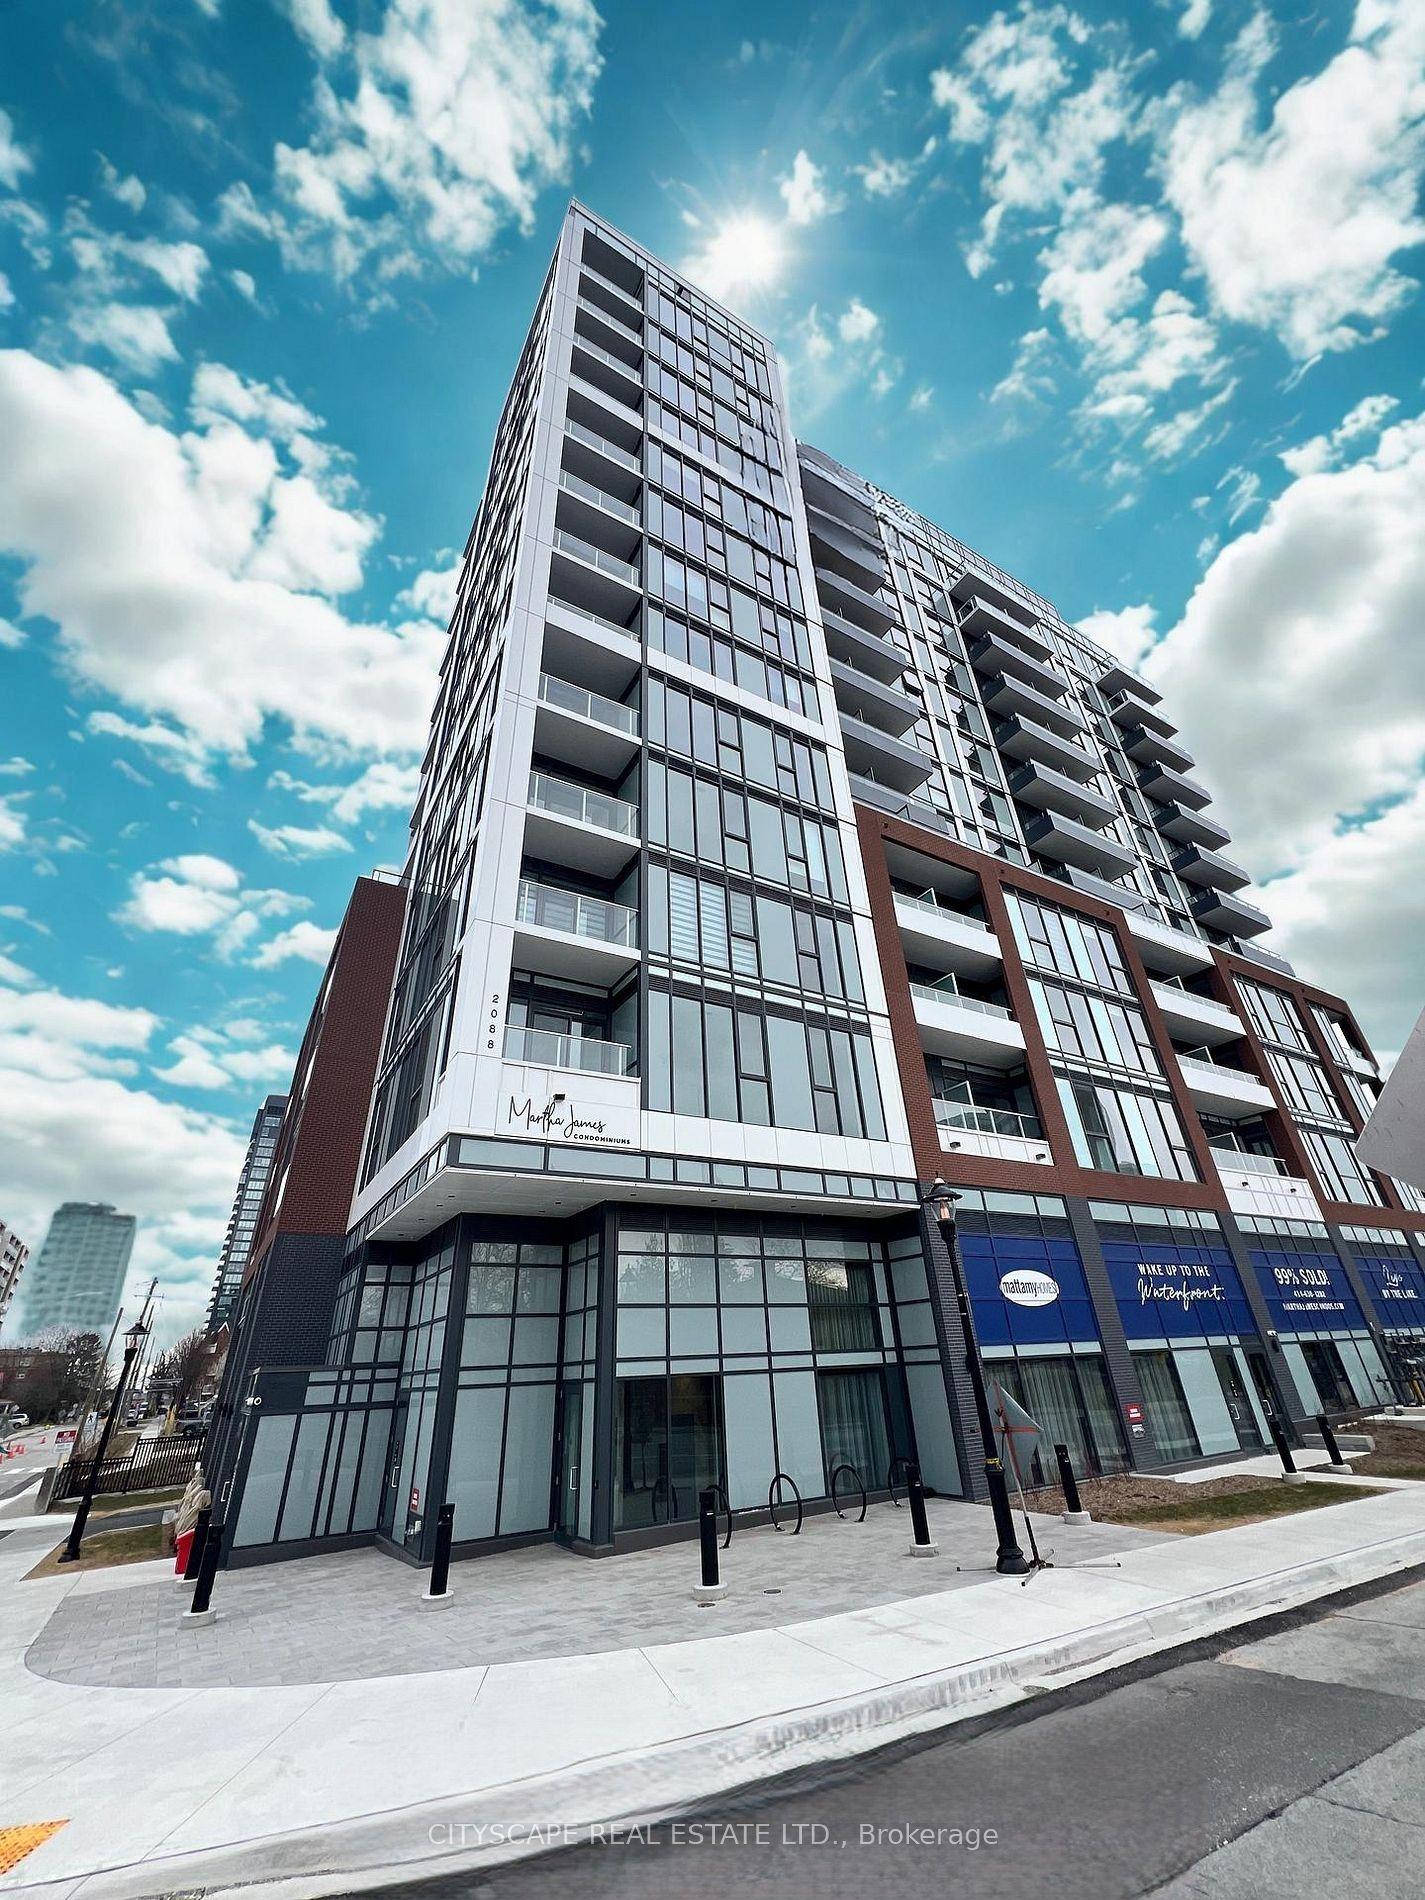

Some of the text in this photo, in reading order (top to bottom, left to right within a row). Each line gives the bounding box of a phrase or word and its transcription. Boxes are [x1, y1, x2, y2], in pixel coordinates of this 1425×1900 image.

[487, 994, 500, 1050] 2088
[508, 1095, 607, 1138] Martha James
[573, 1133, 631, 1145] CONDOMINIUMS
[1137, 1263, 1210, 1277] WAKE UP TO THE
[1274, 1267, 1331, 1286] 99% SOLD!
